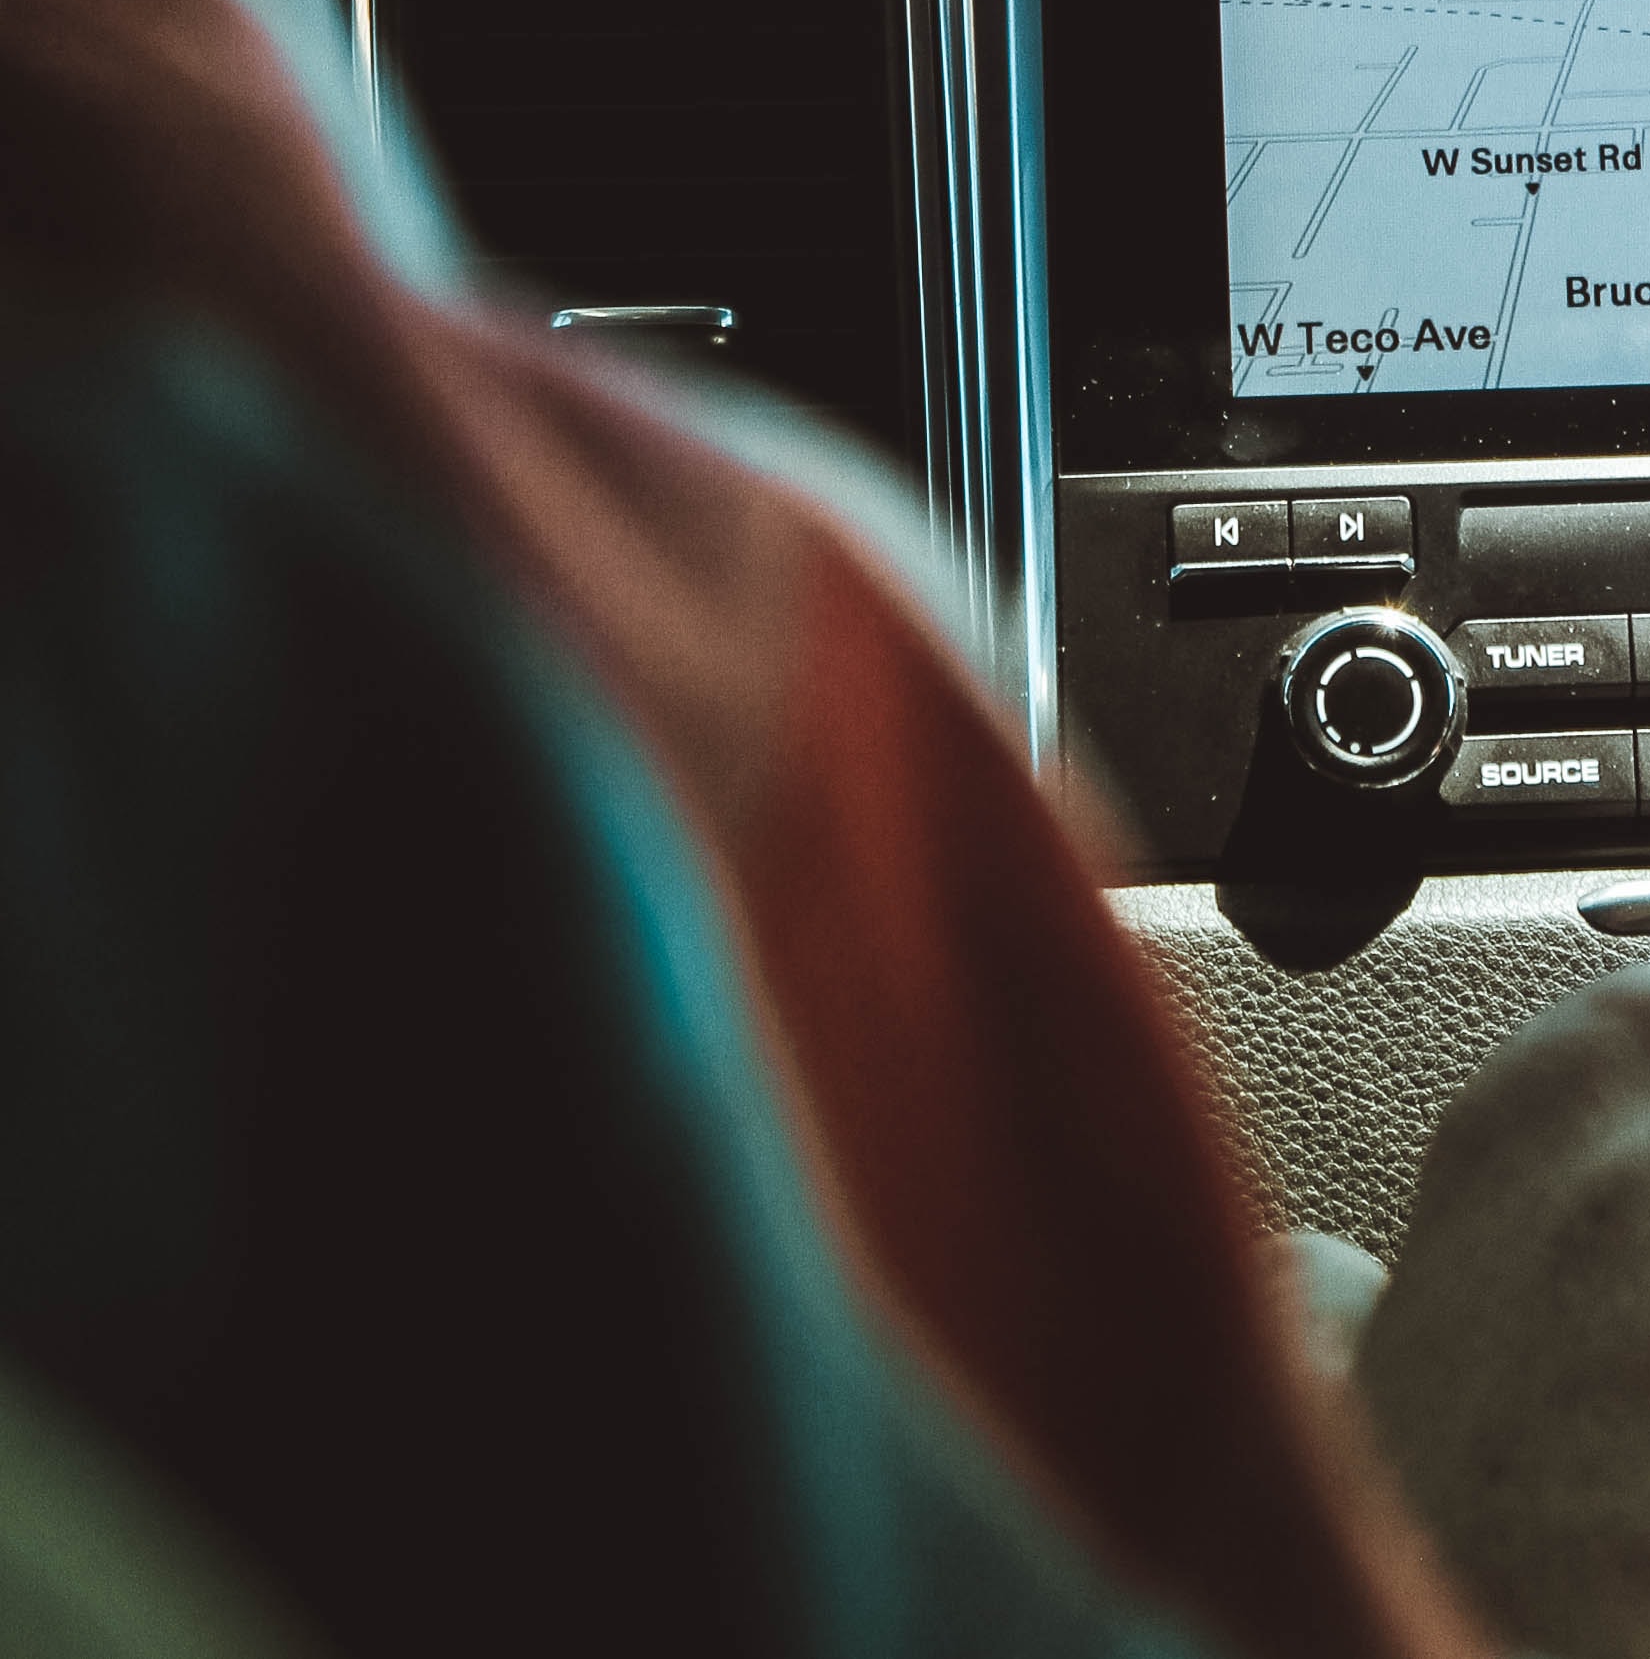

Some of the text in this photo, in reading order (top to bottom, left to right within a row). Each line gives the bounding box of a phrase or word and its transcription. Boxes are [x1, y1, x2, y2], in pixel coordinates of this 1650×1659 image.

[1423, 144, 1642, 175] W Sunset Rd
[1239, 317, 1491, 354] W Teco Ave
[1487, 643, 1585, 668] TUNER
[1481, 759, 1600, 787] SOURCE
